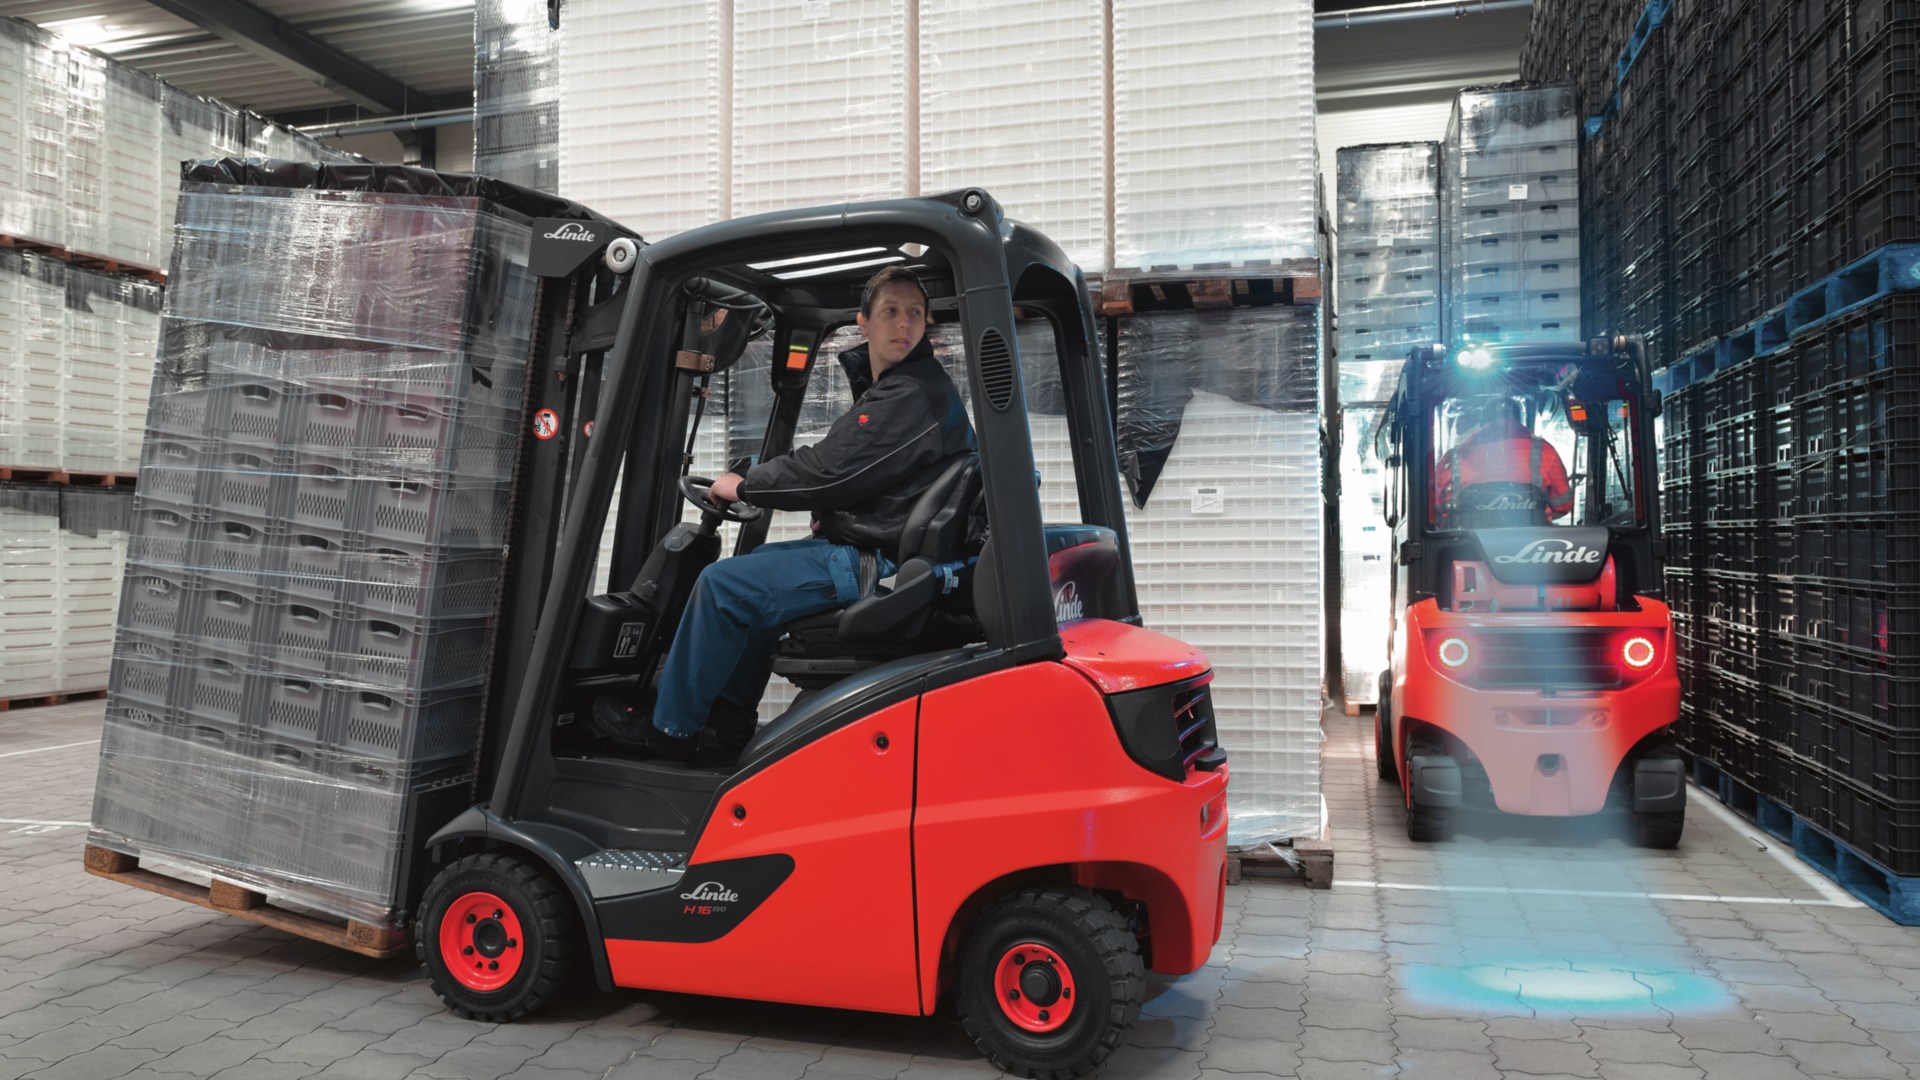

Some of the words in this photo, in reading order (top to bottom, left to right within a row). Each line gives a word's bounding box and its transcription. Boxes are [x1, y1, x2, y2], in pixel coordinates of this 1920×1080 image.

[543, 222, 595, 242] Linde
[1475, 493, 1538, 511] Linde
[1494, 538, 1600, 564] Linde
[680, 881, 739, 902] Linde
